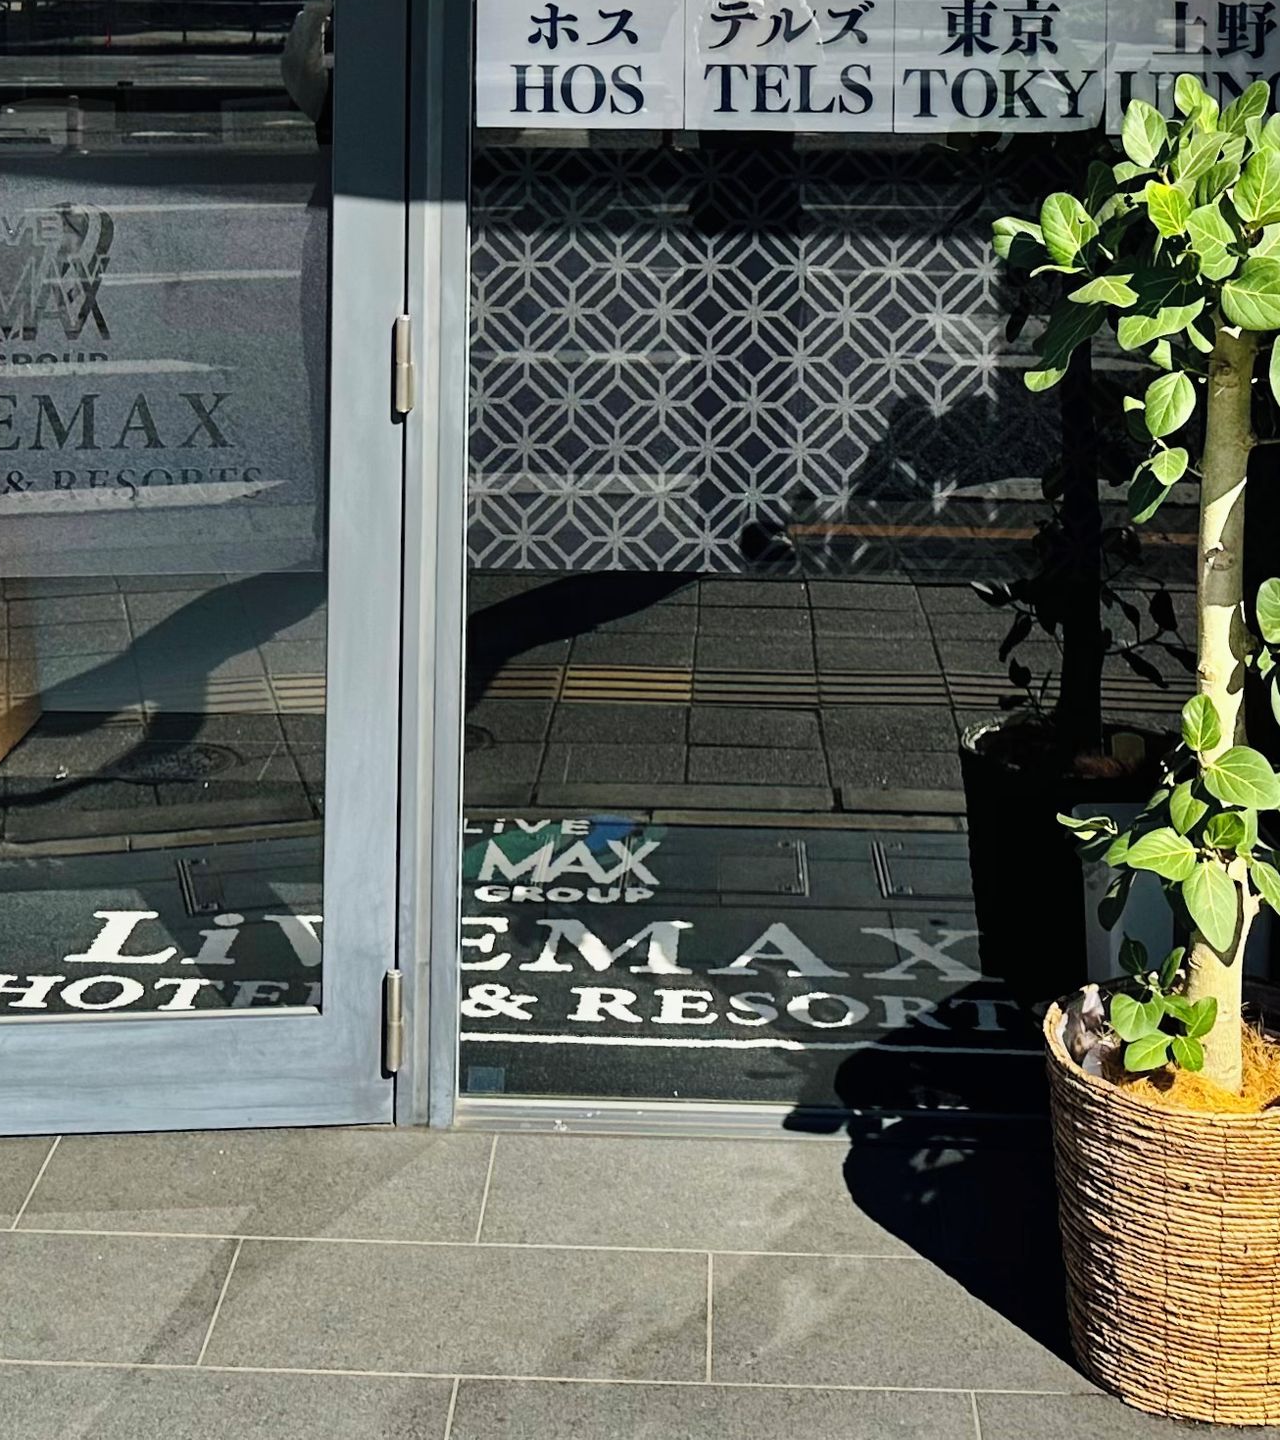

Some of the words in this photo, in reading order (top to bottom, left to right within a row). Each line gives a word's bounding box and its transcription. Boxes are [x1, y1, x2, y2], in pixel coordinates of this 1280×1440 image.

[526, 2, 640, 50] ホス
[709, 0, 875, 50] テルズ
[1152, 0, 1278, 59] 上野
[509, 63, 645, 115] HOS
[703, 63, 874, 115] TELS
[902, 67, 1098, 120] TOKY
[477, 838, 662, 887] MAX
[473, 885, 656, 903] GROUP
[461, 983, 539, 1022] &
